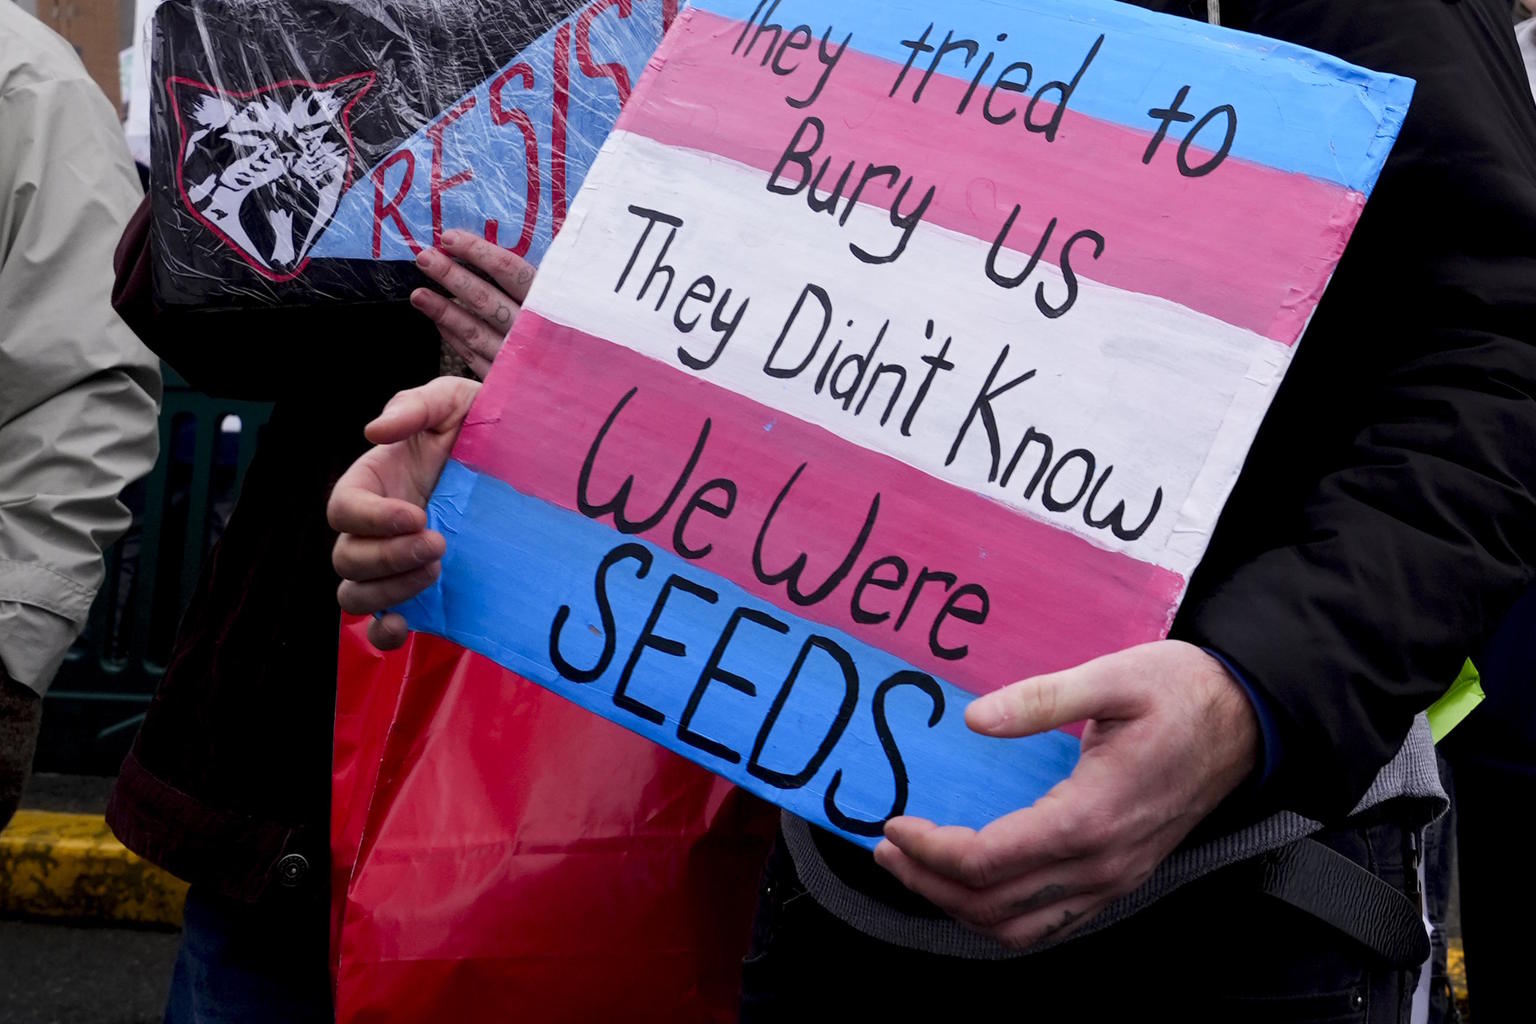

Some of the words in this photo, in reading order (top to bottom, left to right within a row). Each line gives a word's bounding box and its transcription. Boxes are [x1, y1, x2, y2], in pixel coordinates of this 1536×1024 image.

[767, 117, 935, 264] Bury
[890, 22, 1104, 142] tried
[1143, 86, 1236, 177] to
[615, 205, 748, 370] They
[764, 284, 954, 436] Didn't
[940, 340, 1162, 540] Know
[578, 387, 737, 561] We
[748, 464, 989, 664] Were
[550, 538, 949, 840] SEEDS
